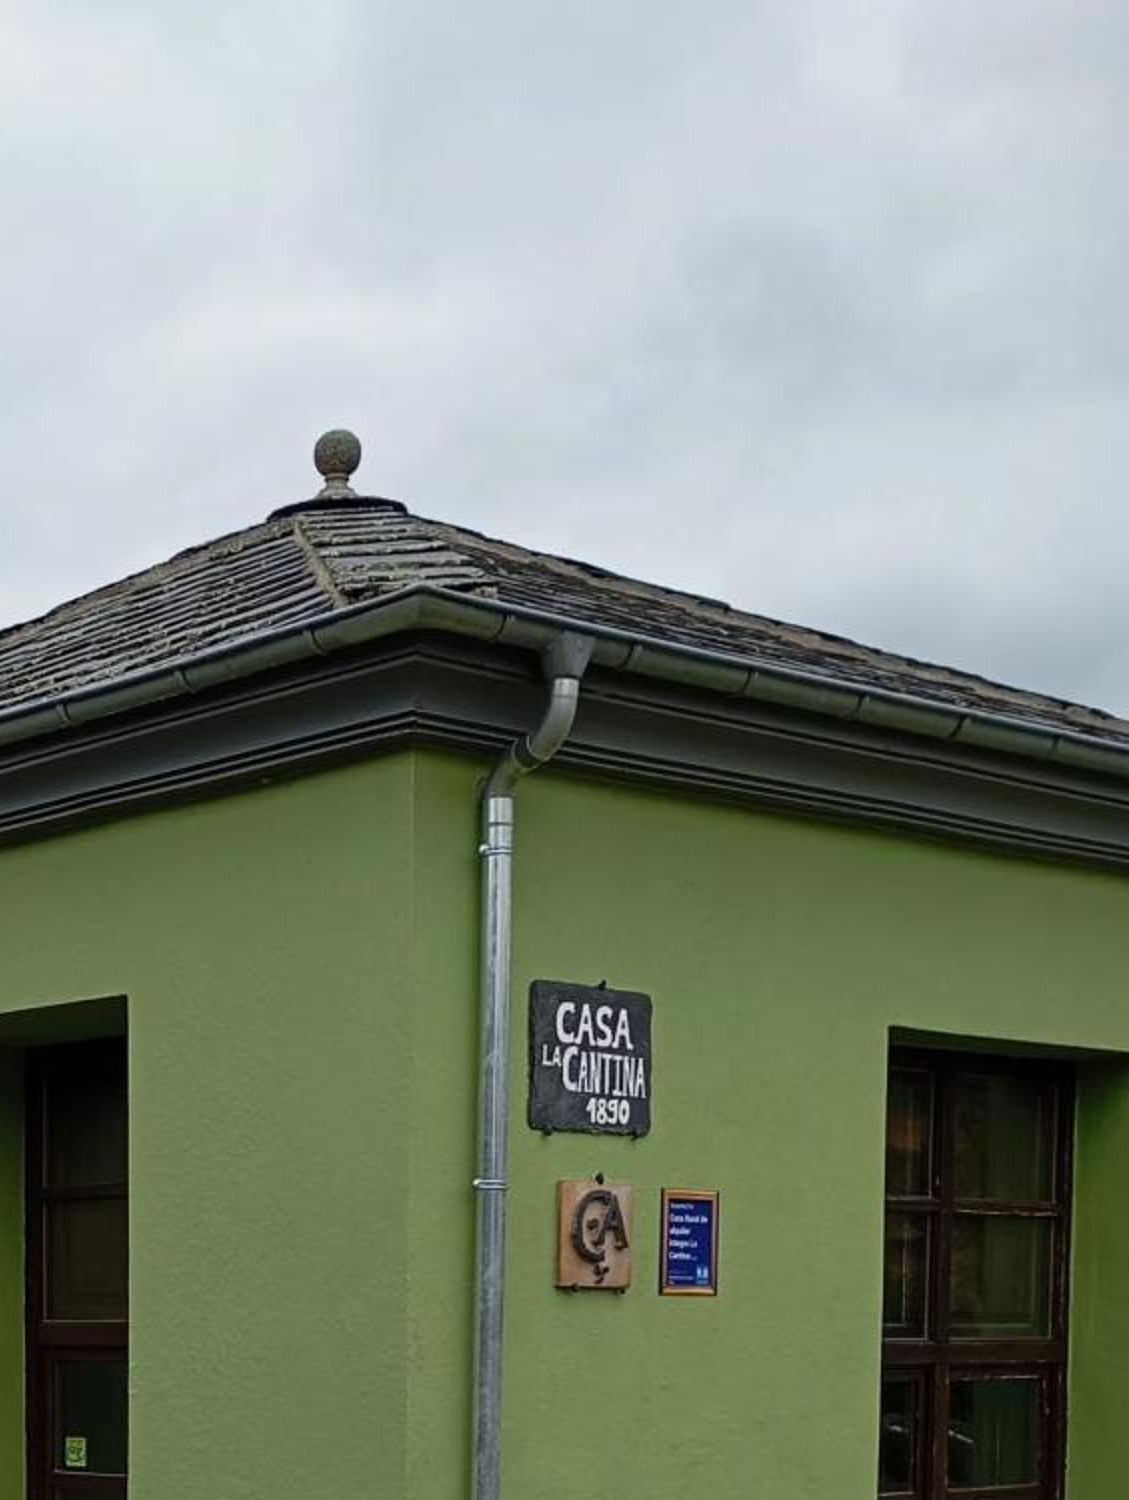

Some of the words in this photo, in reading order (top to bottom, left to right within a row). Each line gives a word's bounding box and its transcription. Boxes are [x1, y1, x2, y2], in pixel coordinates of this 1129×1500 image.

[556, 1001, 634, 1050] CASA
[542, 1044, 561, 1067] LA
[562, 1046, 646, 1098] CANTINA
[585, 1098, 630, 1124] 1890
